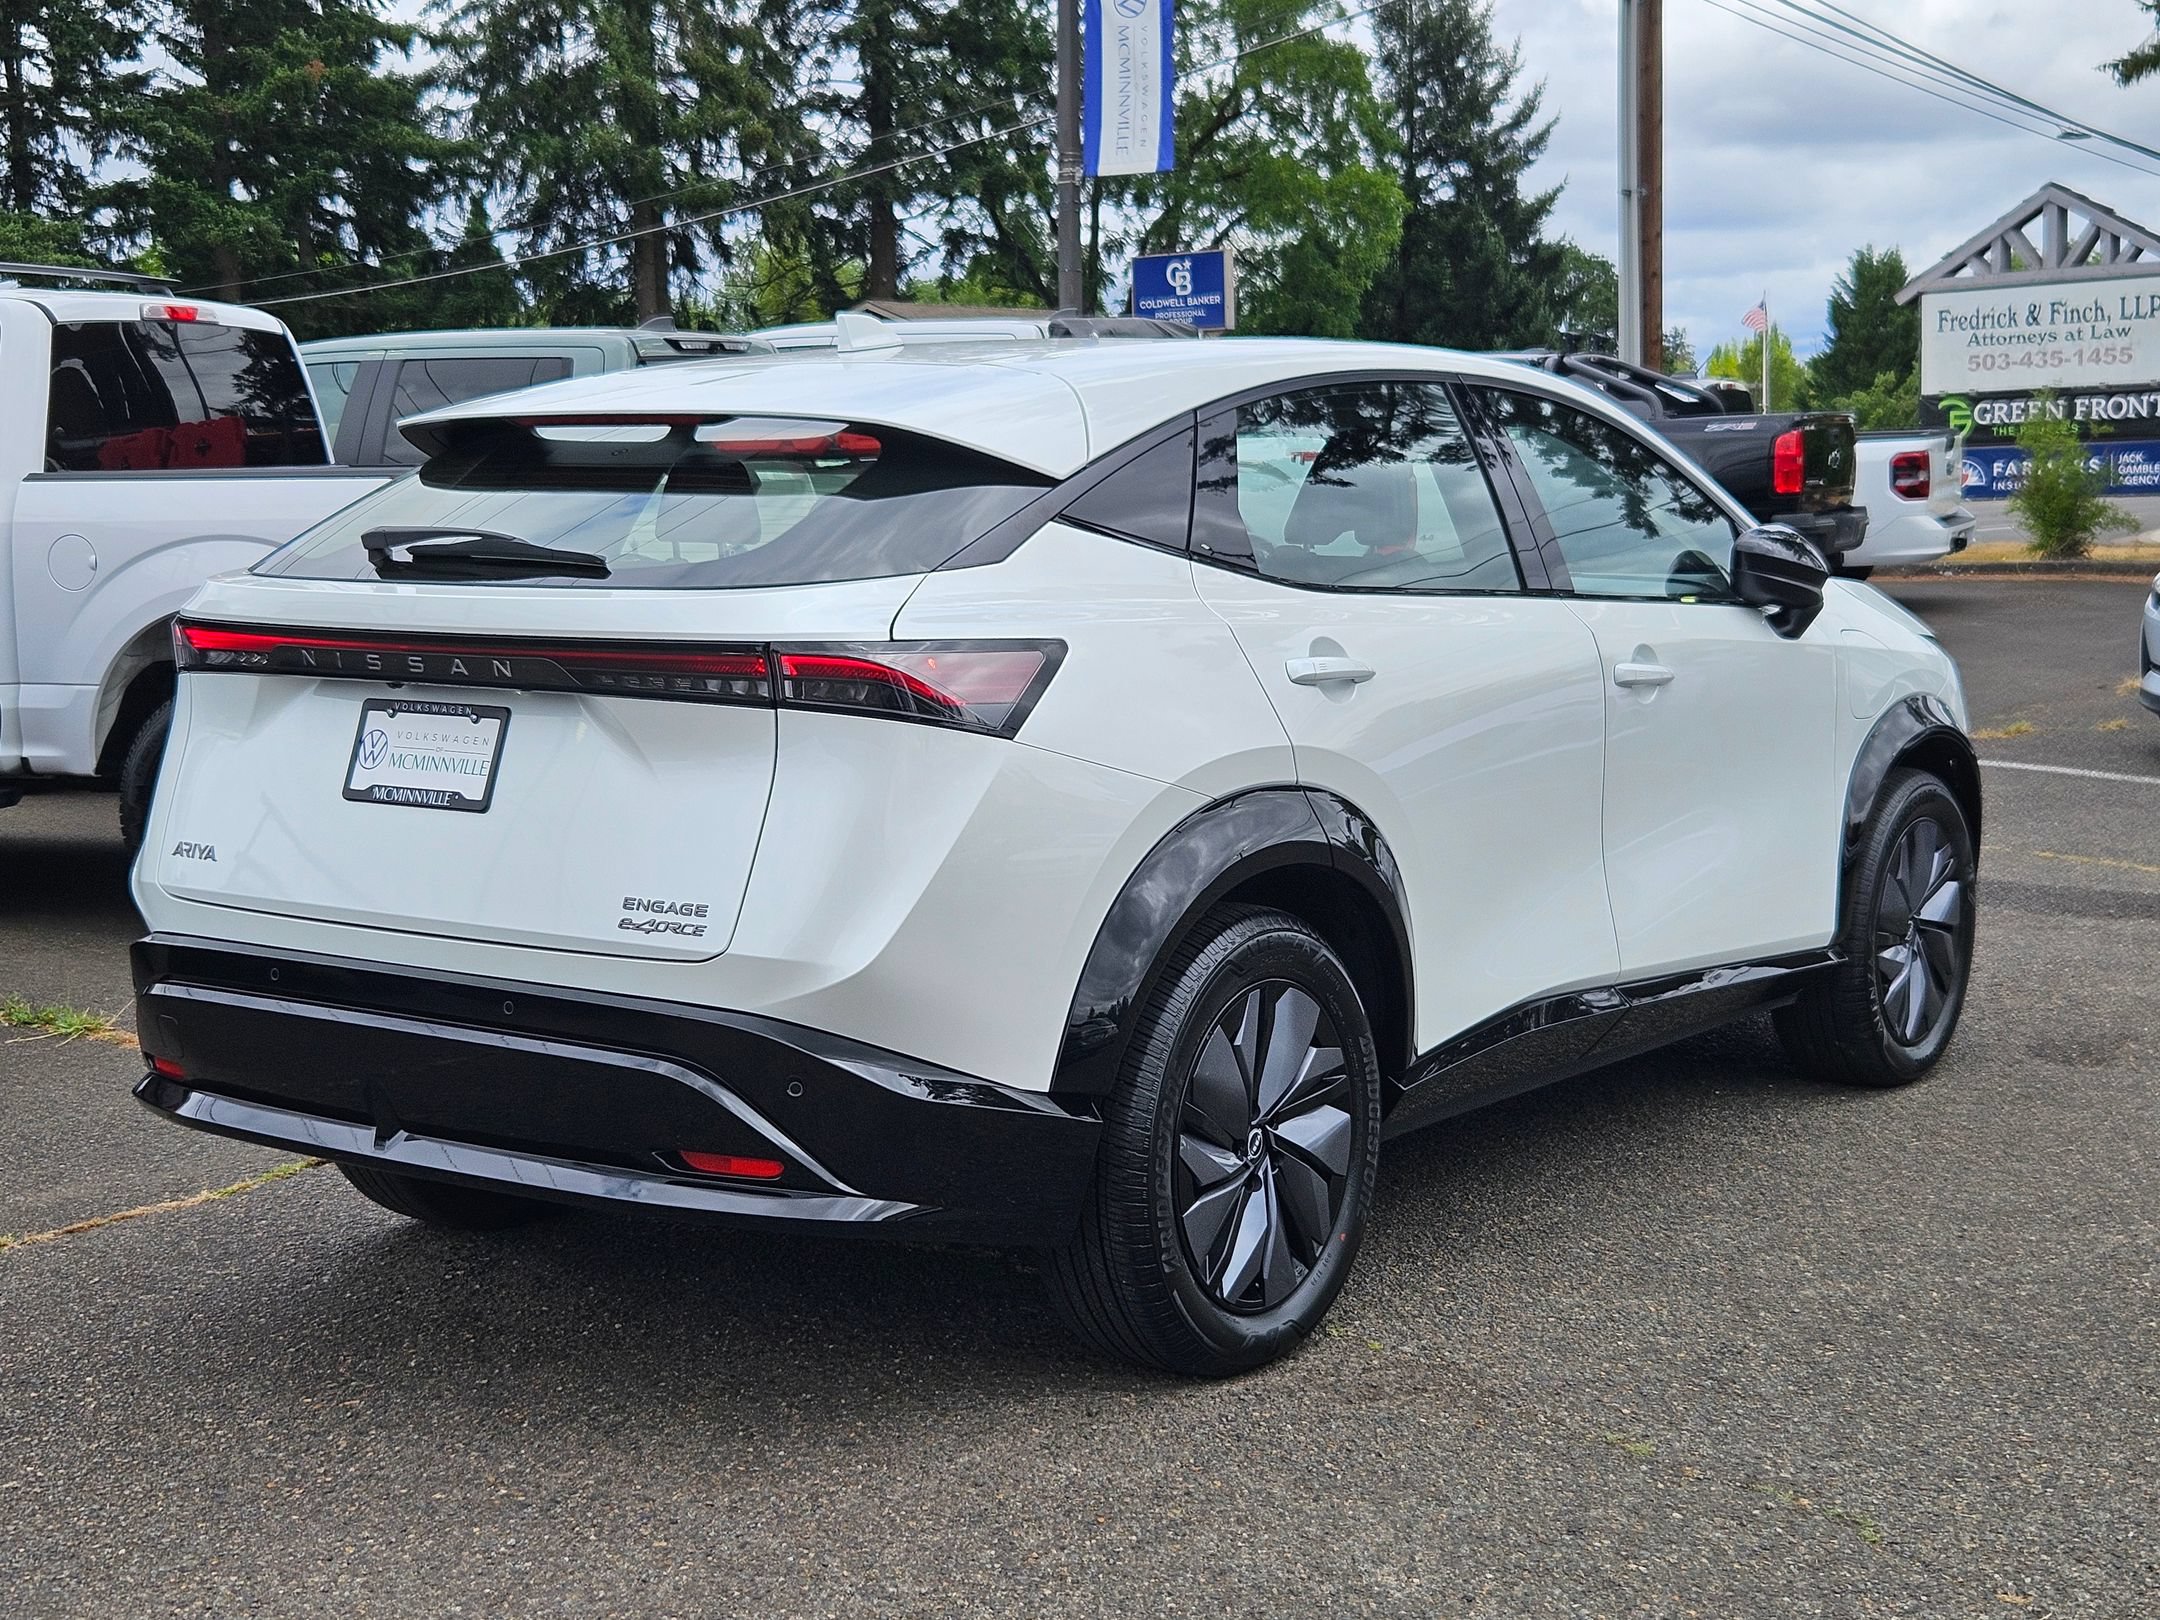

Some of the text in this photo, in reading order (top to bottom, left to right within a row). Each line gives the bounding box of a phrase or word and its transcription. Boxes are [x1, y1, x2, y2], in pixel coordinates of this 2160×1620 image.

[1115, 25, 1133, 156] MCMINNVILLE
[1140, 25, 1149, 148] VOLKSWAGEN
[1139, 295, 1221, 310] COLDWELL BANKER
[1936, 293, 2160, 333] Fredrick & Finch, LLP
[1154, 310, 1207, 320] PROFESSIONAL
[1966, 324, 2132, 348] Attorneys at Law
[1967, 347, 2134, 372] 503-435-1455
[1973, 399, 2067, 426] GREEN
[1992, 426, 2016, 437] THE
[2117, 462, 2160, 475] GAMBLE
[2118, 453, 2144, 464] JACK
[301, 649, 514, 679] NISSAN
[394, 702, 473, 716] VOLKSWAGEN
[397, 731, 491, 747] VOLKSWAGEN
[387, 752, 491, 777] MCMINNVILLE
[372, 786, 453, 806] MCMINNVILLE
[171, 840, 218, 863] ARIYA
[621, 896, 710, 918] ENGAGE
